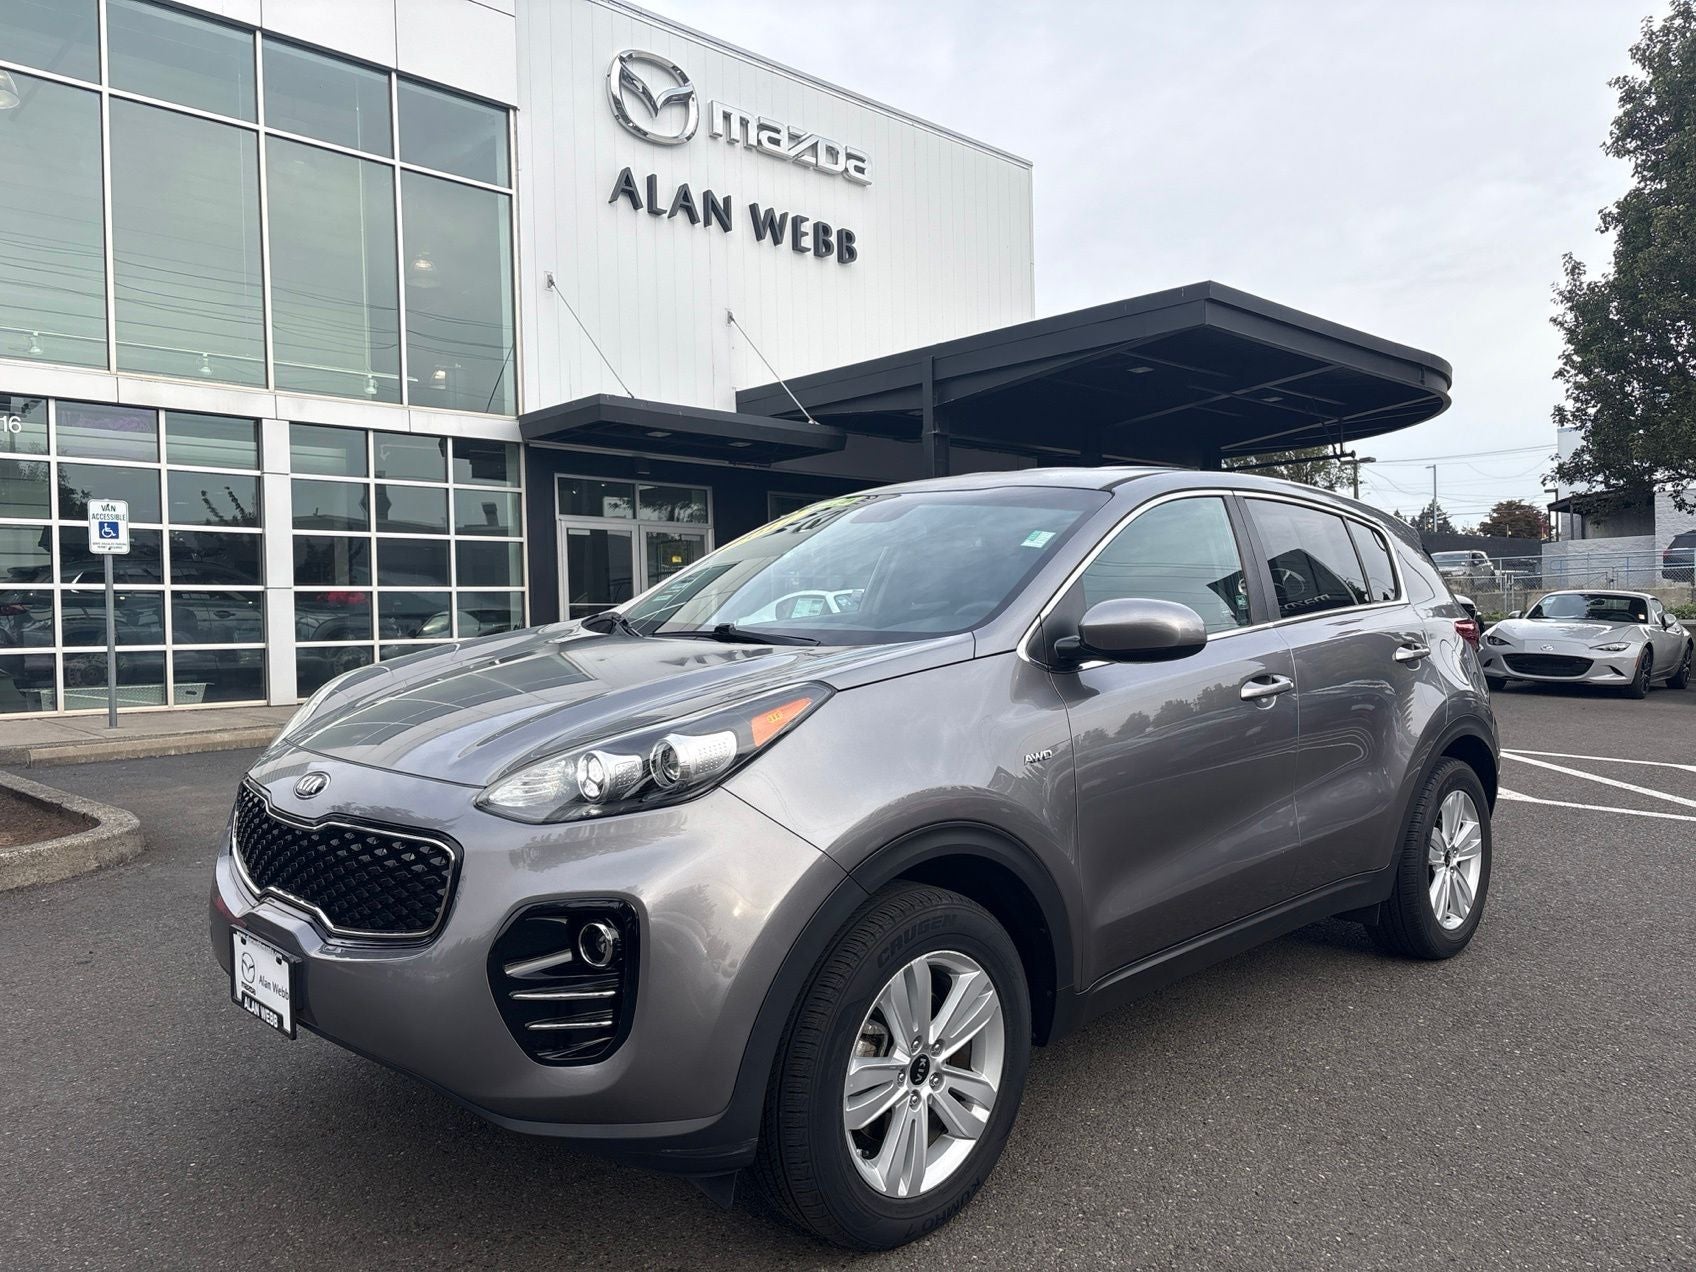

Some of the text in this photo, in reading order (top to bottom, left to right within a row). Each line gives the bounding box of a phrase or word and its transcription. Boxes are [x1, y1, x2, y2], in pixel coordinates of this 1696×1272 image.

[608, 167, 858, 264] ALAN WEBB
[91, 513, 126, 521] ACCESSIBLE
[101, 504, 117, 512] VAN
[1024, 749, 1053, 766] AWD
[296, 775, 323, 794] KIA
[877, 913, 958, 968] CRUGEN
[258, 974, 289, 1001] Alan Webb
[244, 995, 279, 1029] ALAN WEBB
